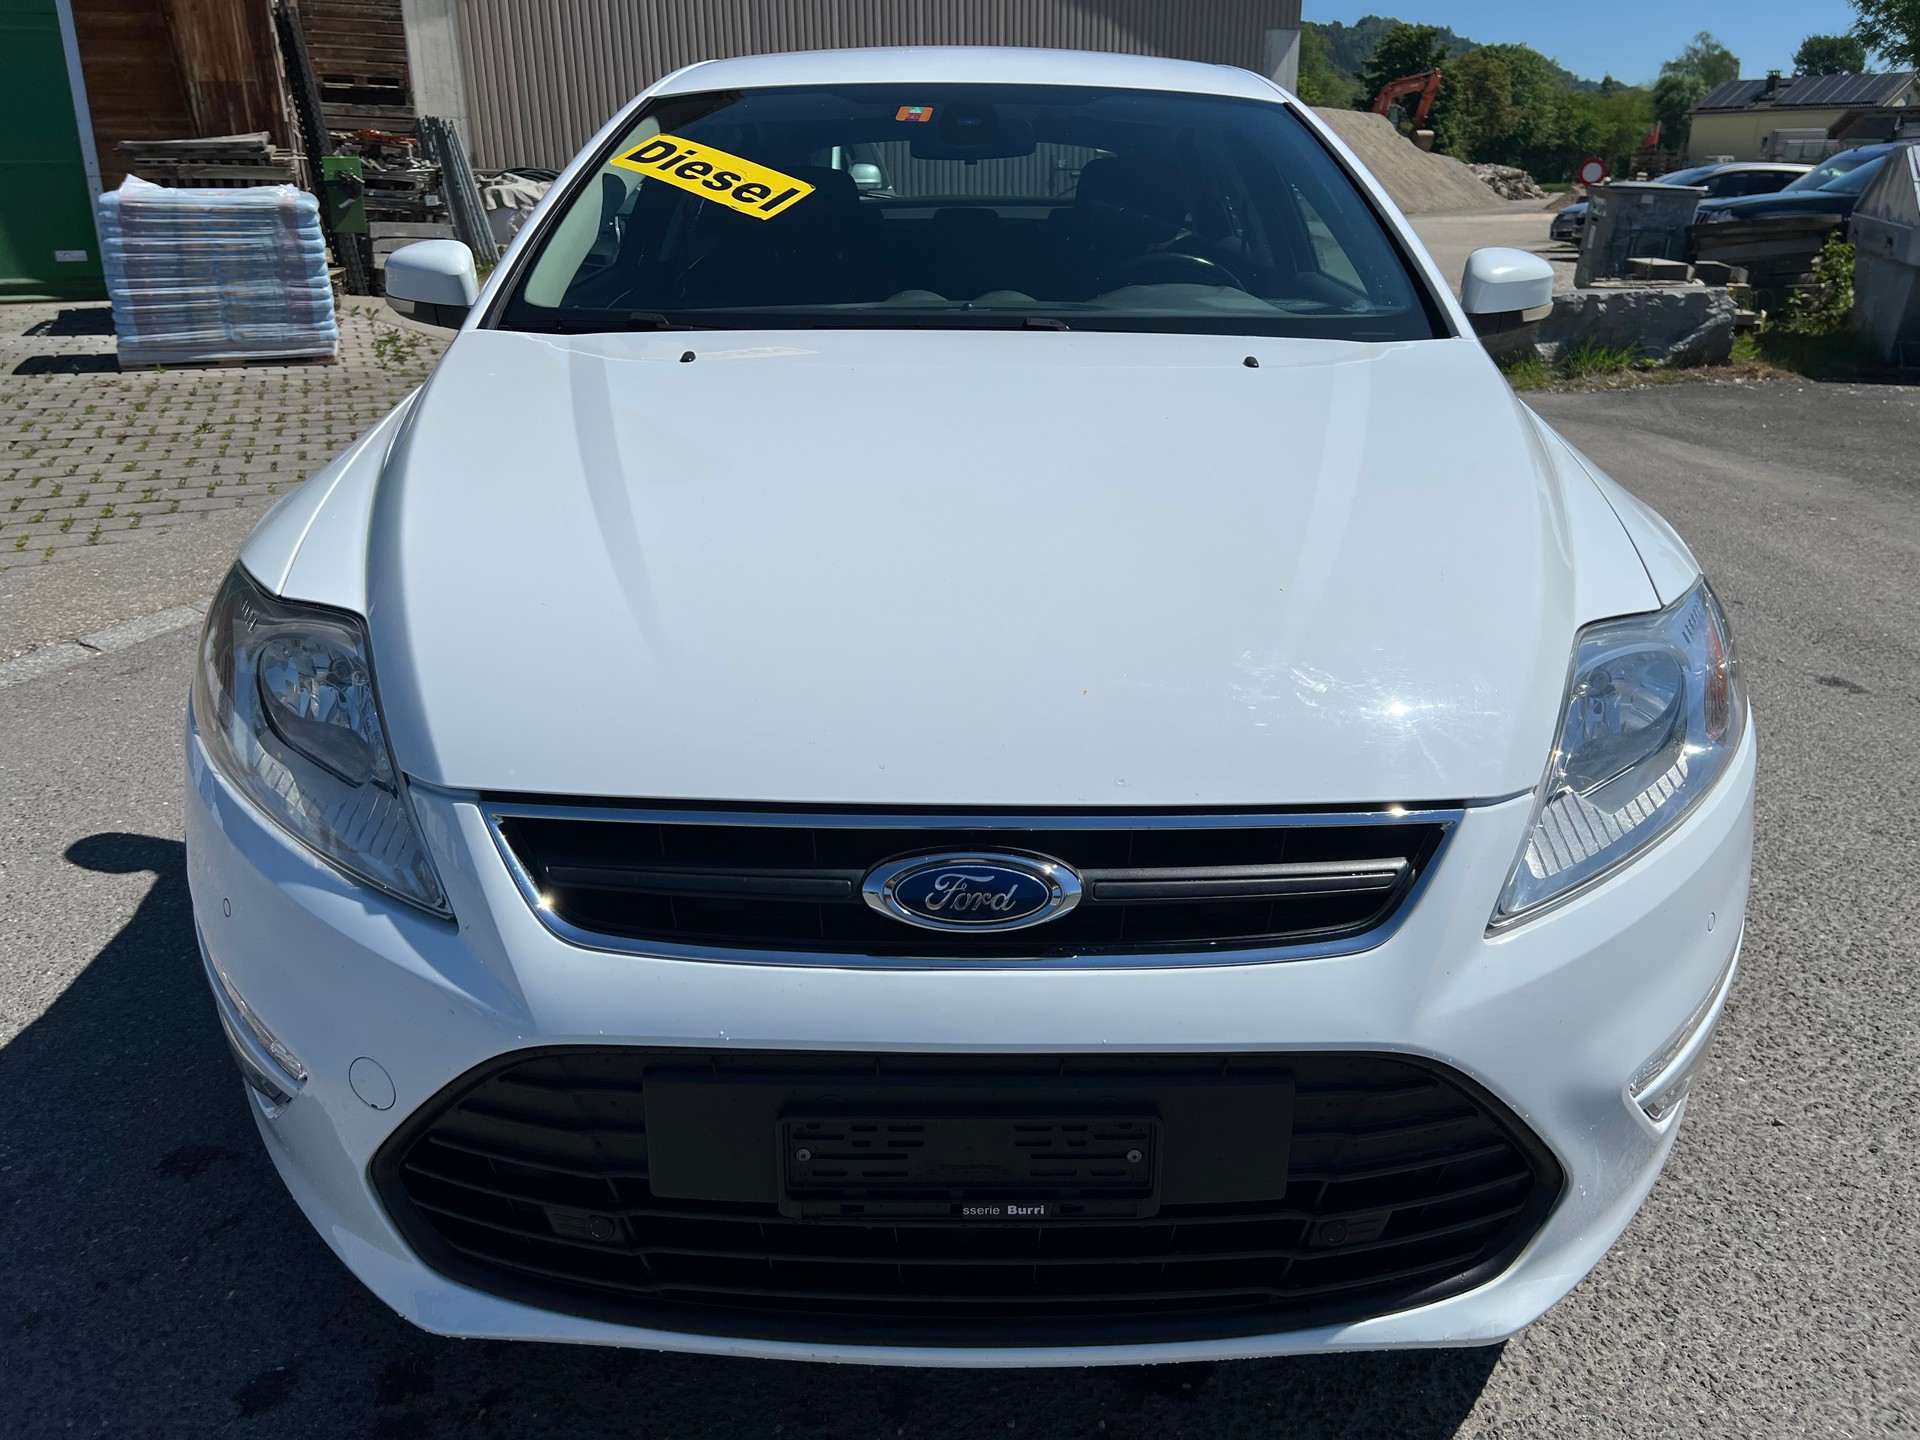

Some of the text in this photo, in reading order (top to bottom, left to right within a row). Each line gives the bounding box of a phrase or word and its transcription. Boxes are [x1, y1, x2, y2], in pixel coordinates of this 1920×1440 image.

[625, 140, 801, 212] Diesel
[924, 873, 1019, 911] Ford
[962, 1204, 1045, 1215] sserie Burri
